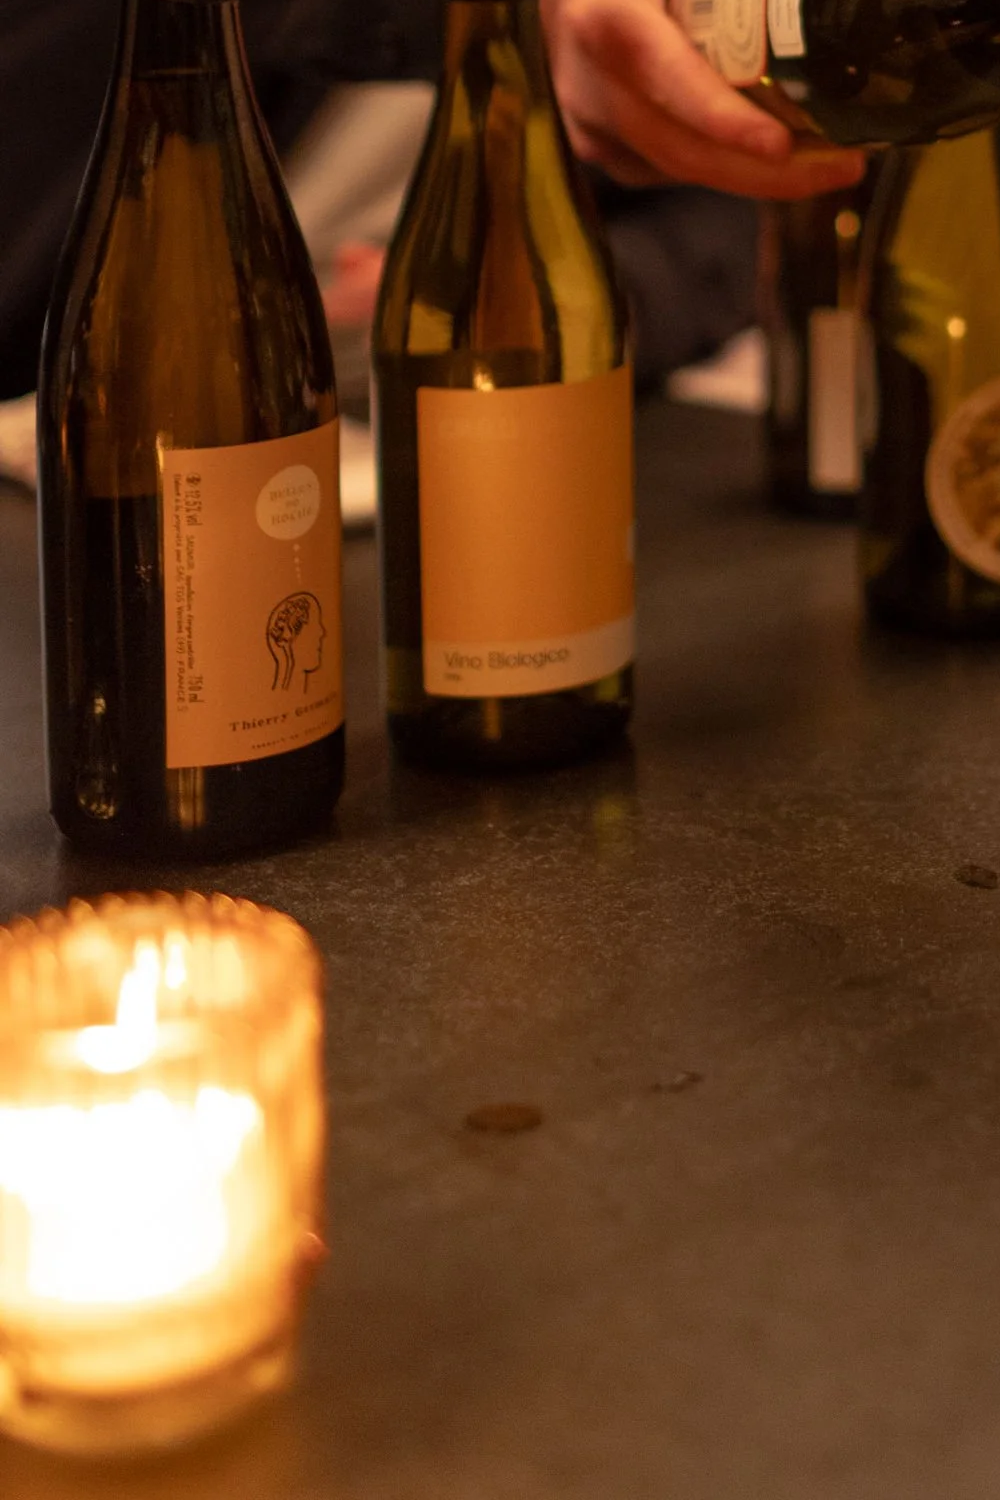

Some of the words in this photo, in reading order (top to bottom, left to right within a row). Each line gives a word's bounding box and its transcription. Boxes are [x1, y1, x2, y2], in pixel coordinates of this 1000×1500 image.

[443, 651, 483, 670] Vino
[488, 647, 571, 670] Biologico
[177, 660, 186, 703] FRANCE
[229, 711, 290, 732] Thierry
